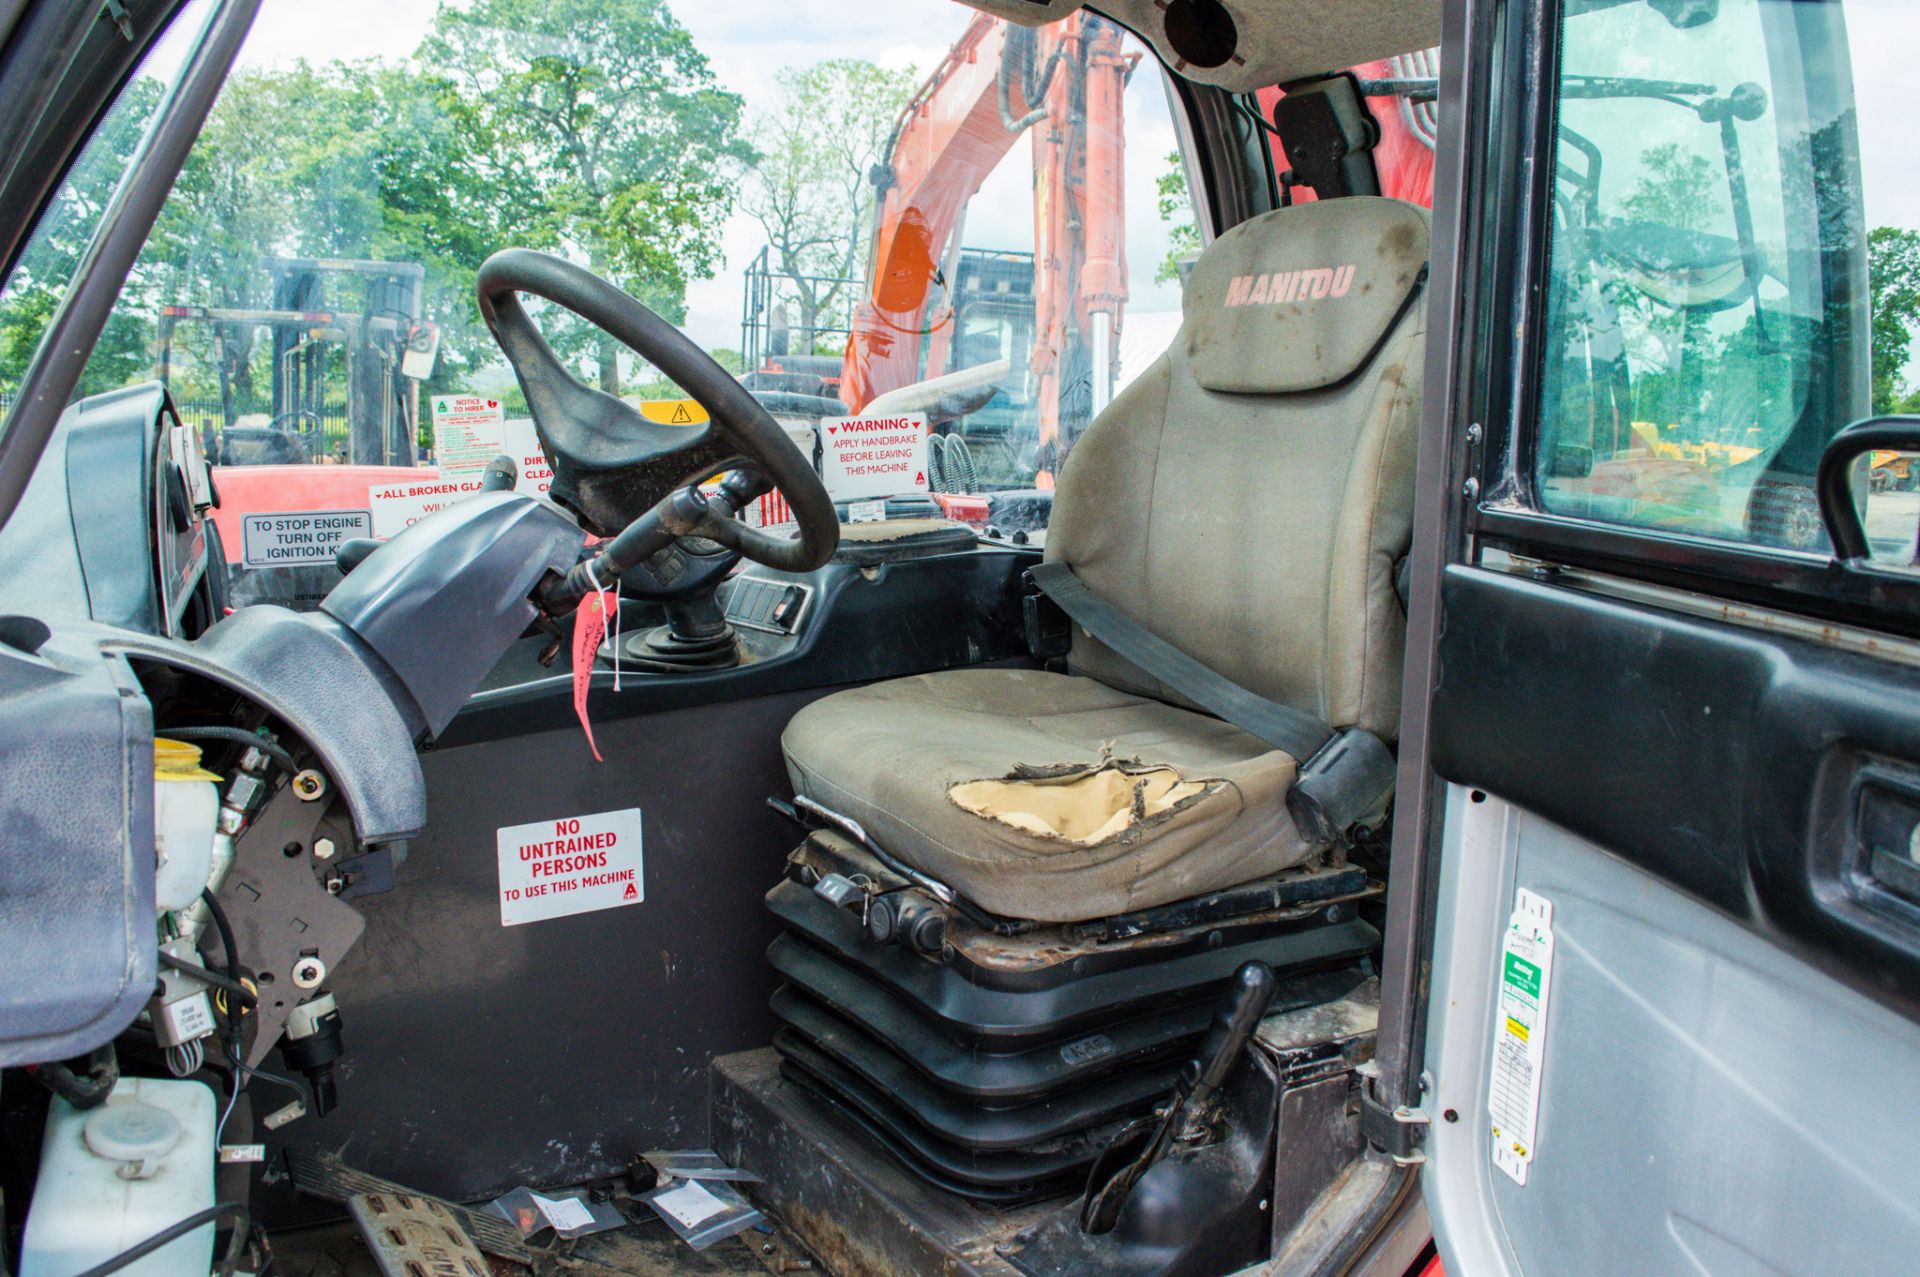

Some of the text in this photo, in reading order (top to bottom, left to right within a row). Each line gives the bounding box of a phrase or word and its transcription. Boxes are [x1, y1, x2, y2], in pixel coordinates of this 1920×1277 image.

[1224, 265, 1356, 307] MANITOU
[841, 418, 909, 433] WARNING
[834, 434, 917, 449] APPLY HANDBRAKE
[840, 449, 912, 462] BEFORE LEAVING
[525, 469, 557, 479] CLEA
[846, 462, 908, 476] THIS MACHINE
[383, 489, 406, 499] ALL
[409, 484, 458, 497] BROKEN
[254, 517, 362, 532] TO STOP ENGINE
[276, 531, 342, 545] TURN OFF
[267, 545, 341, 559] IGNITION K
[556, 819, 580, 837] NO
[519, 832, 617, 861] UNTRAINED
[532, 852, 607, 878] PERSONS
[504, 869, 636, 901] TO USE THIS MACHINE
